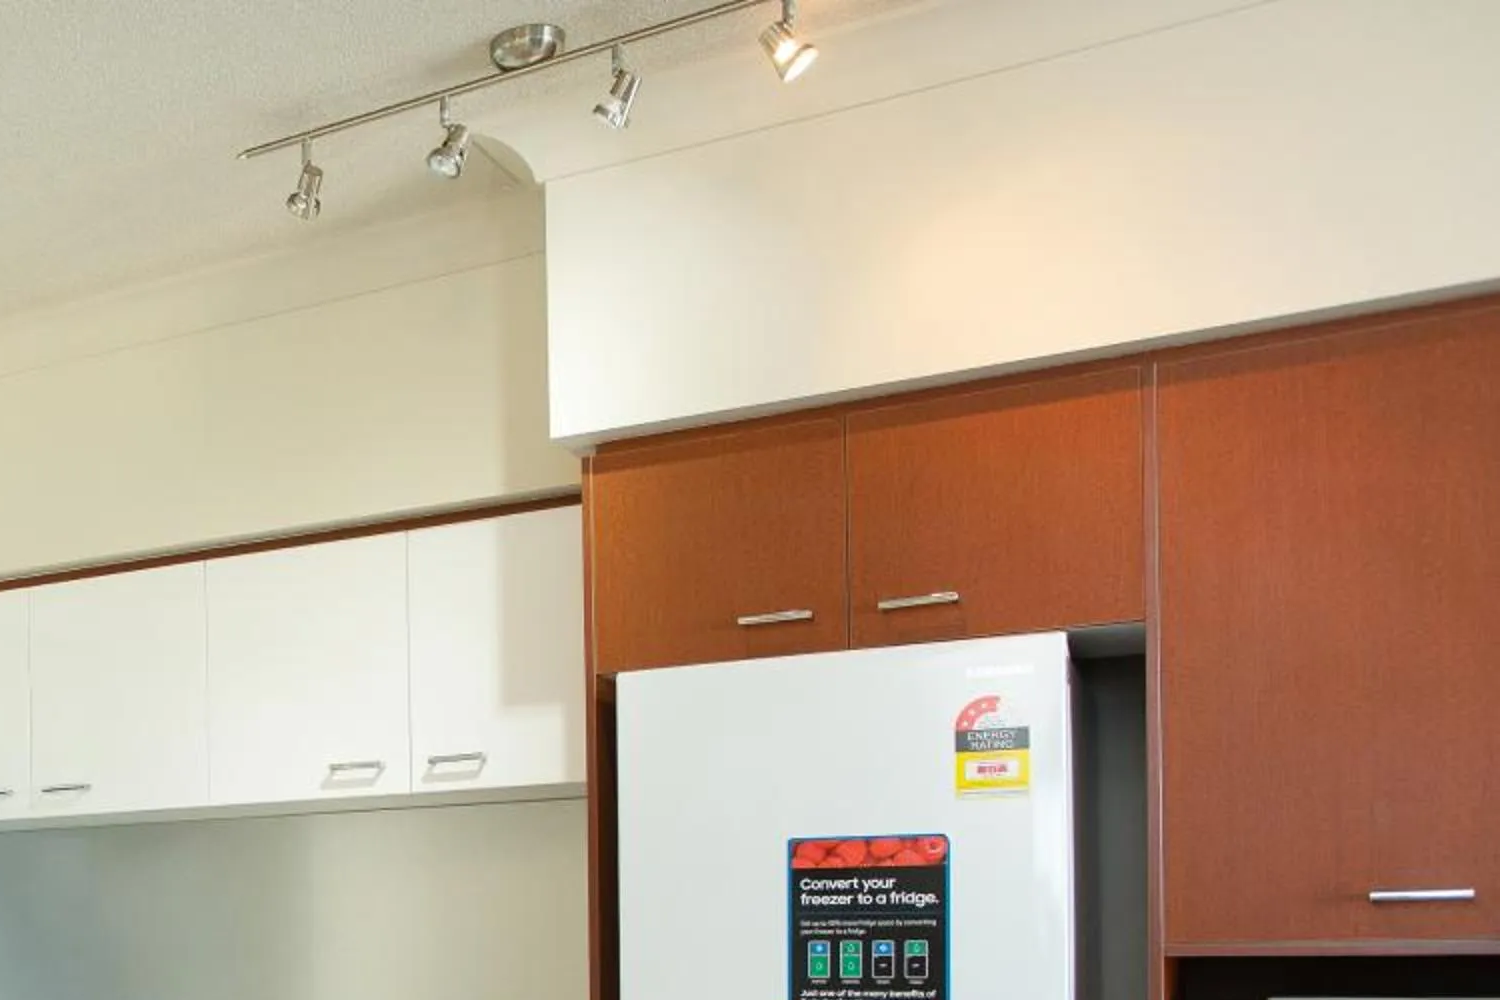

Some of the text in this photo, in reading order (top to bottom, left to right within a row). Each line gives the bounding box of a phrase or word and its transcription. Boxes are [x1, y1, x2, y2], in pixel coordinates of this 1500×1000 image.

[967, 730, 1016, 741] ENERGY
[970, 739, 1014, 750] RATING
[800, 877, 897, 893] Convert your
[800, 891, 940, 908] freezer to a fridge.
[800, 989, 818, 998] Just
[835, 989, 846, 998] of
[847, 989, 861, 998] the
[889, 988, 924, 998] benefits
[925, 989, 937, 998] of
